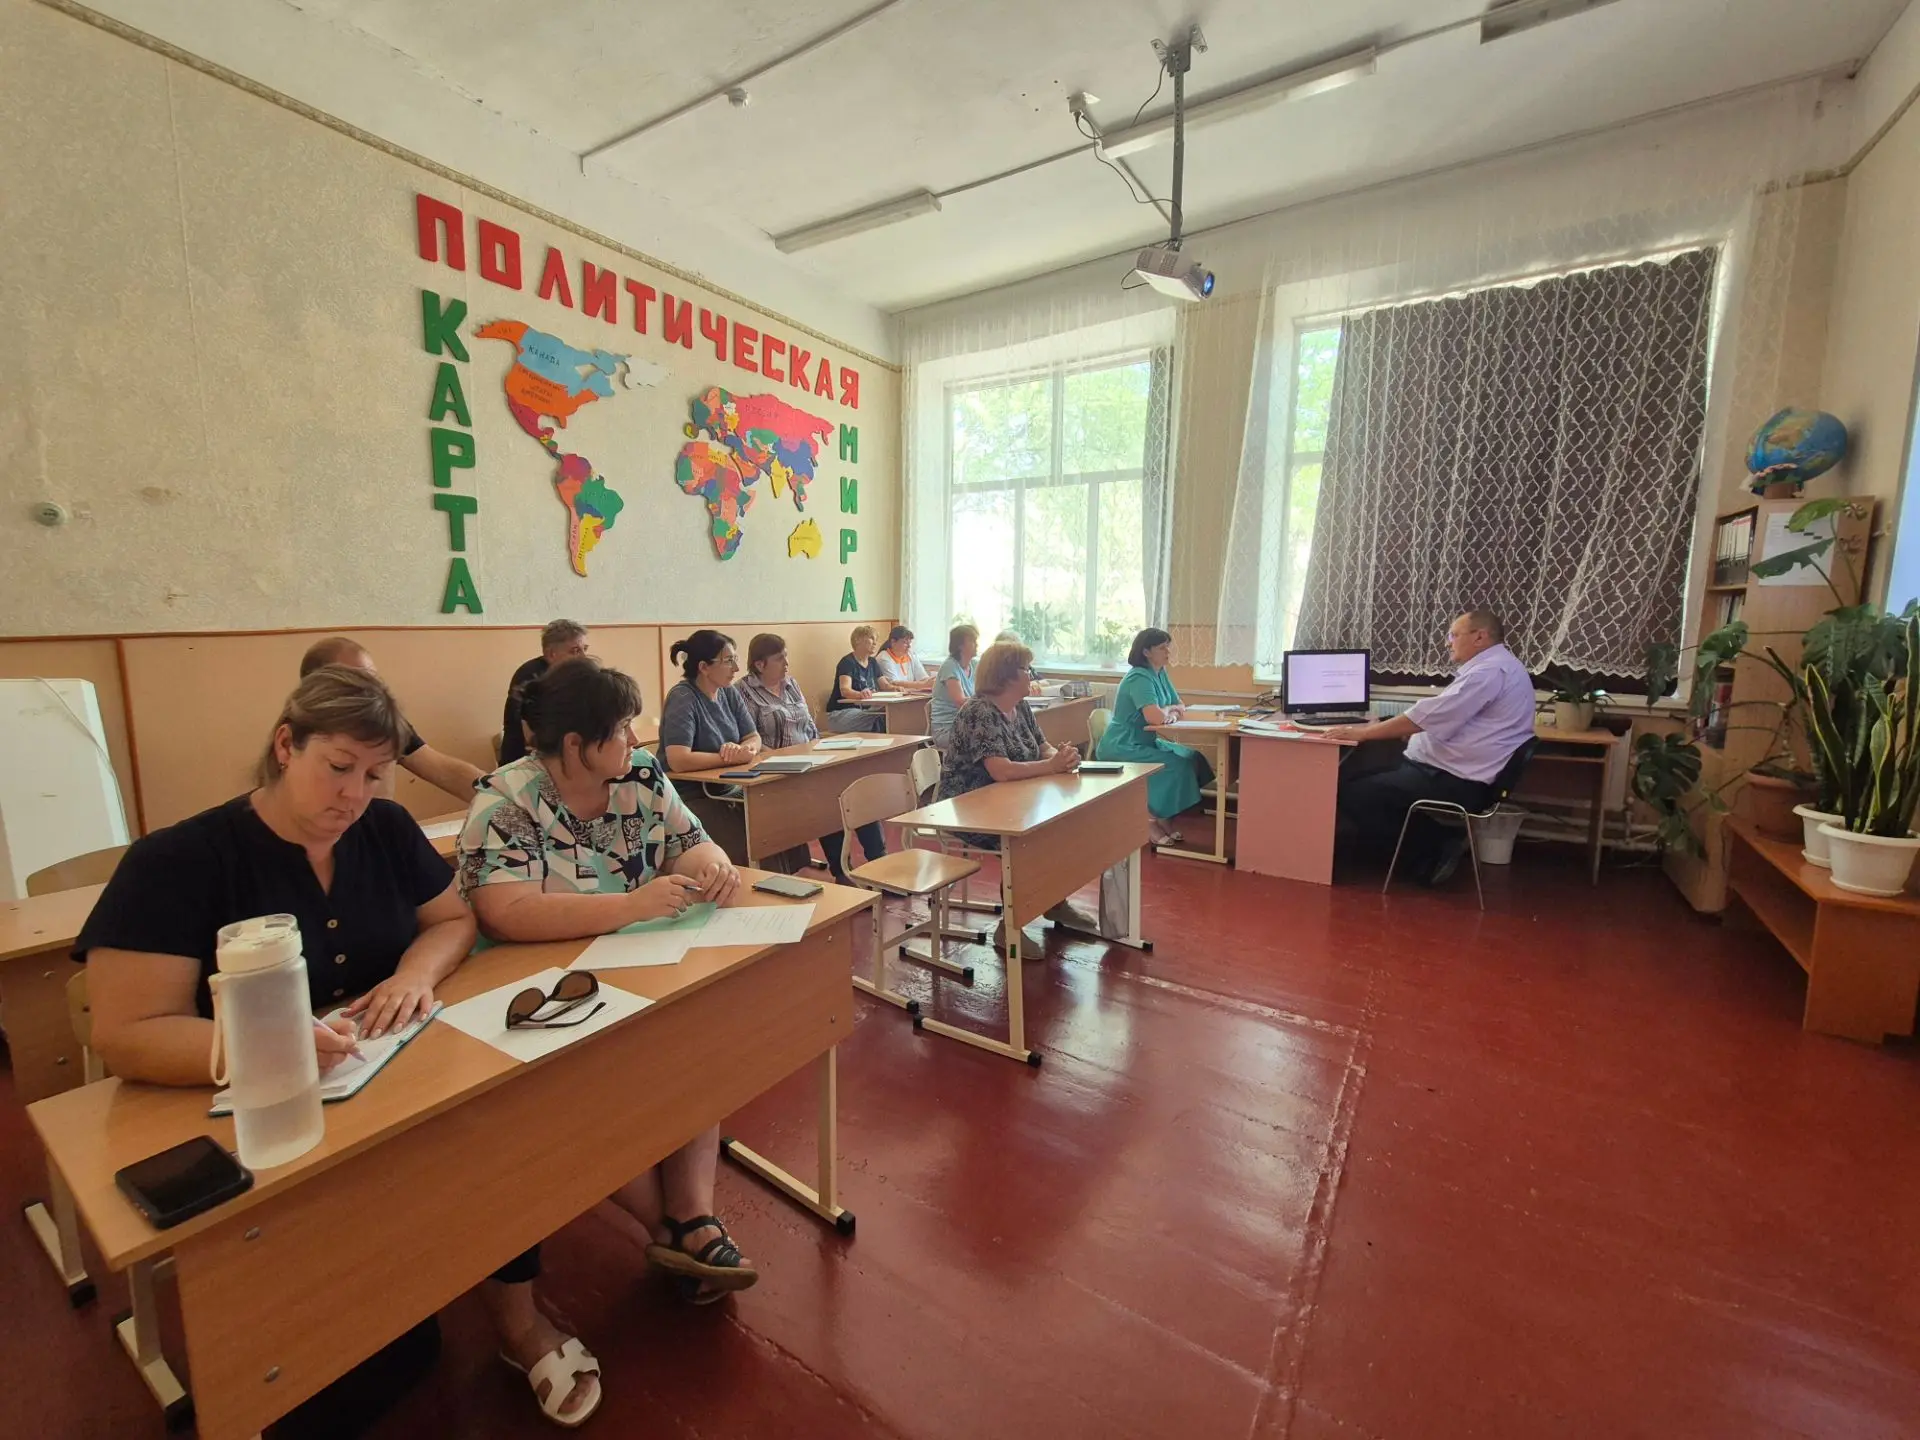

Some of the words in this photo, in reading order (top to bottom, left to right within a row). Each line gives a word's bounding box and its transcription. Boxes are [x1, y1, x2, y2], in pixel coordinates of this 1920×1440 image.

[416, 193, 860, 410] ПОЛИТИЧЕСКАЯ
[528, 345, 560, 366] КАНАДА
[422, 289, 484, 614] КАРТА
[839, 423, 859, 612] МИРА
